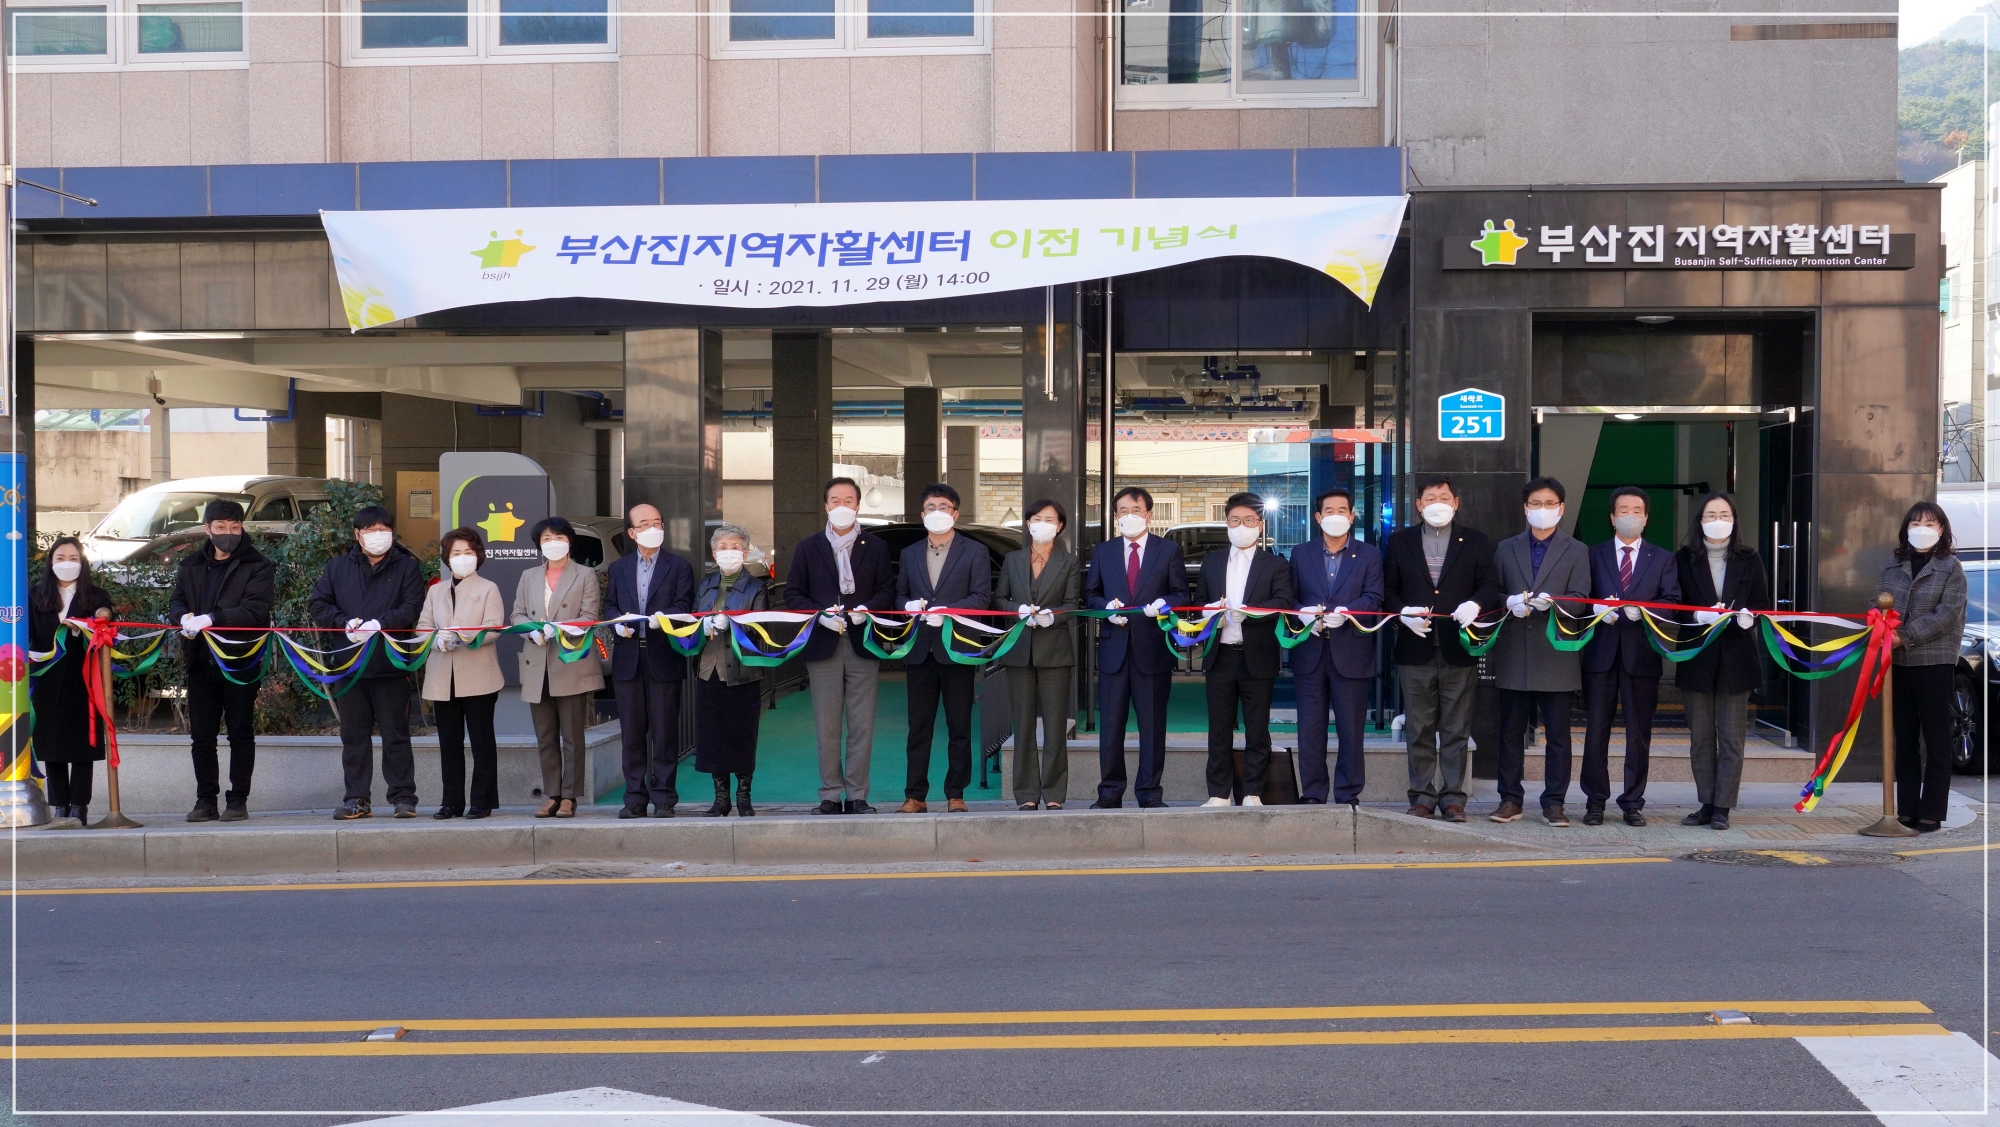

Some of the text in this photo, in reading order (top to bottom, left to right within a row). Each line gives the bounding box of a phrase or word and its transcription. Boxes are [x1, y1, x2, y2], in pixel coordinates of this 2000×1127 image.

[556, 230, 972, 268] 부산진지역자활센터
[989, 227, 1080, 259] 이전
[1537, 223, 1891, 263] 부산진 지역자활센터
[1674, 257, 1887, 267] Busanjin Self-Sufficiency Promotion Center
[482, 271, 511, 281] bsjjh
[865, 276, 891, 291] 29
[896, 273, 929, 291] (월)
[936, 271, 991, 287] 14:00
[1451, 416, 1492, 434] 251
